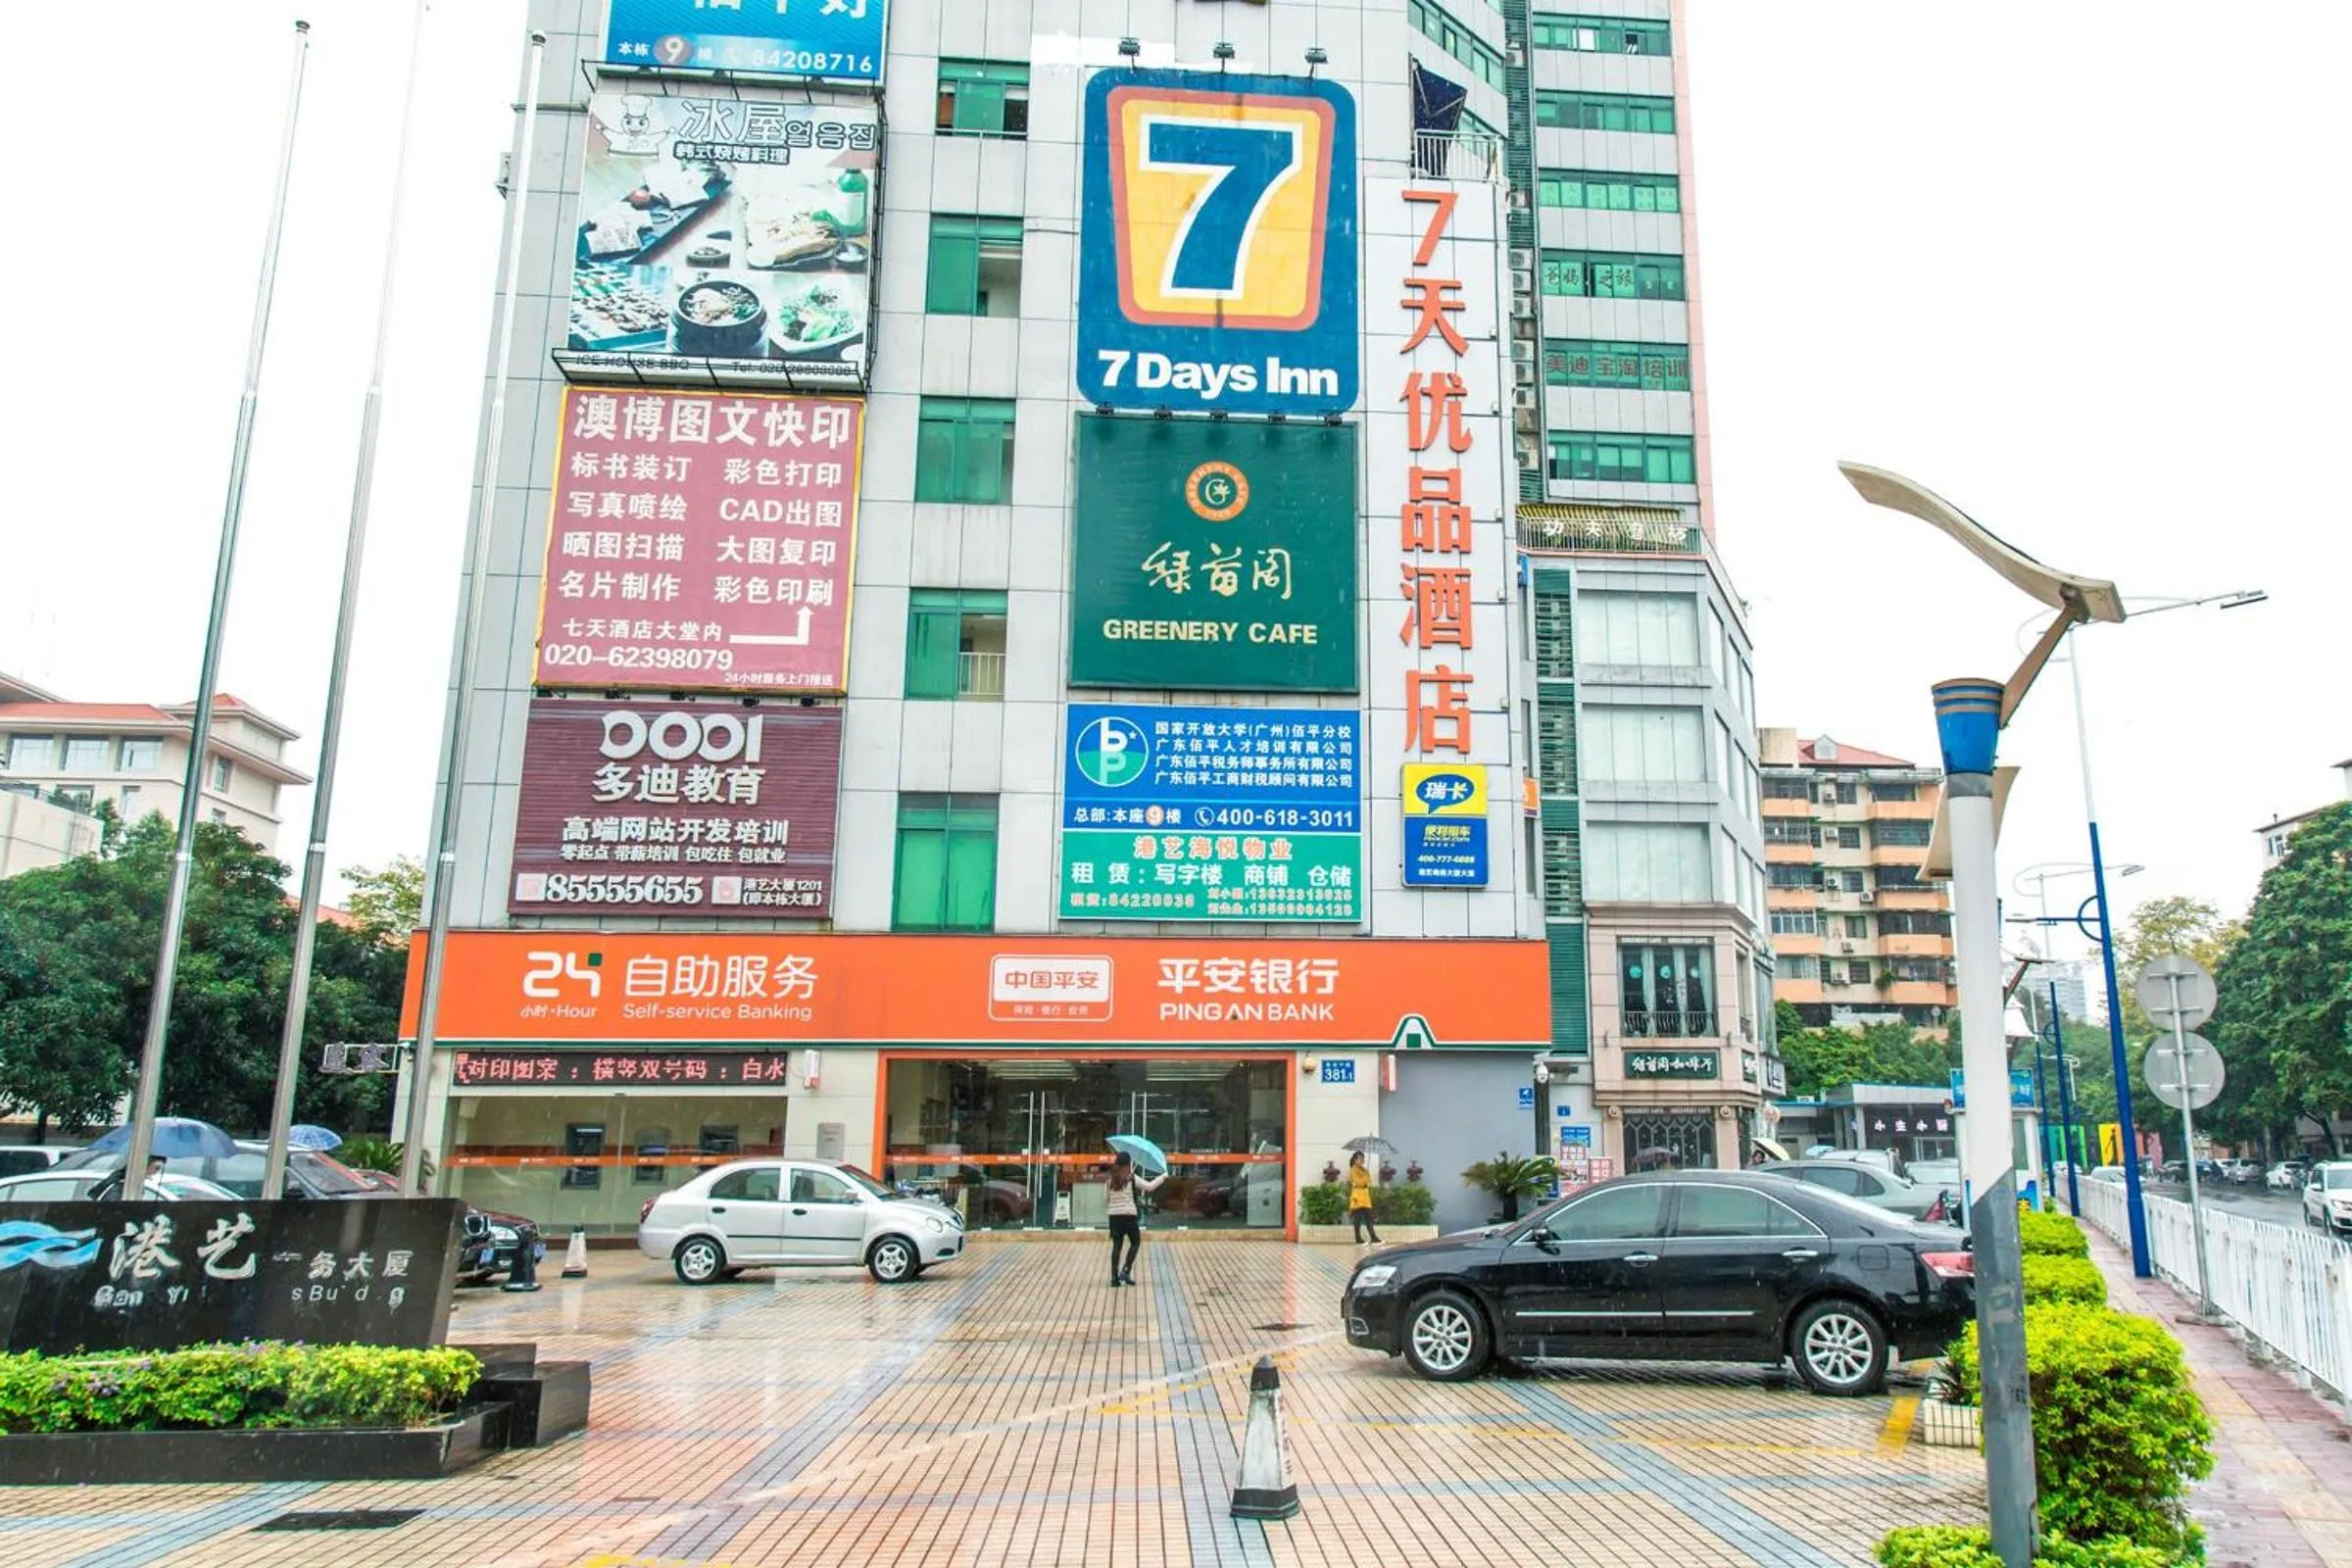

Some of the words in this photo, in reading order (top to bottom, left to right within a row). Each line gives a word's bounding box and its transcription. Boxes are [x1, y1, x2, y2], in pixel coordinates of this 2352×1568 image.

[752, 50, 873, 73] 84208716
[679, 99, 785, 146] 冰屋
[786, 119, 876, 151] 얼음집
[1139, 114, 1303, 300] 7
[1098, 350, 1131, 387] 7
[1137, 352, 1257, 401] Days
[1266, 357, 1340, 397] Inn
[573, 395, 851, 449] 澳博图文快印
[571, 452, 692, 482] 标书装订
[723, 458, 843, 488] 彩色打印
[1400, 189, 1474, 754] 7天优品酒店
[566, 491, 688, 521] 写真喷绘
[719, 498, 843, 528] CAD出图
[563, 531, 685, 562] 晒图扫描
[715, 535, 836, 566] 大图复印
[559, 569, 681, 601] 名片制作
[713, 575, 834, 607] 彩色印刷
[562, 618, 722, 642] 七天酒店大堂内
[1103, 619, 1239, 643] GREENERY
[1249, 623, 1318, 644] CAFE
[545, 643, 733, 670] 020-62398079
[1154, 738, 1353, 755] 广东佰平人才培训有限公司
[591, 761, 766, 805] 多迪教育
[562, 815, 789, 846] 高端网站开发培训
[1216, 808, 1353, 826] 400-618-3011
[1133, 835, 1293, 860] 港艺海悦物业
[546, 873, 705, 904] 85555655
[1244, 864, 1289, 886] 商铺
[1306, 865, 1353, 886] 仓储
[624, 954, 818, 999] 自助服务
[1004, 970, 1100, 990] 中国平安
[1157, 957, 1341, 996] 平安银行
[622, 1003, 733, 1020] Self-service
[737, 1003, 813, 1022] Banking
[1267, 1003, 1335, 1021] BANK
[109, 1212, 258, 1282] 港艺
[272, 1250, 414, 1279] 务大厦
